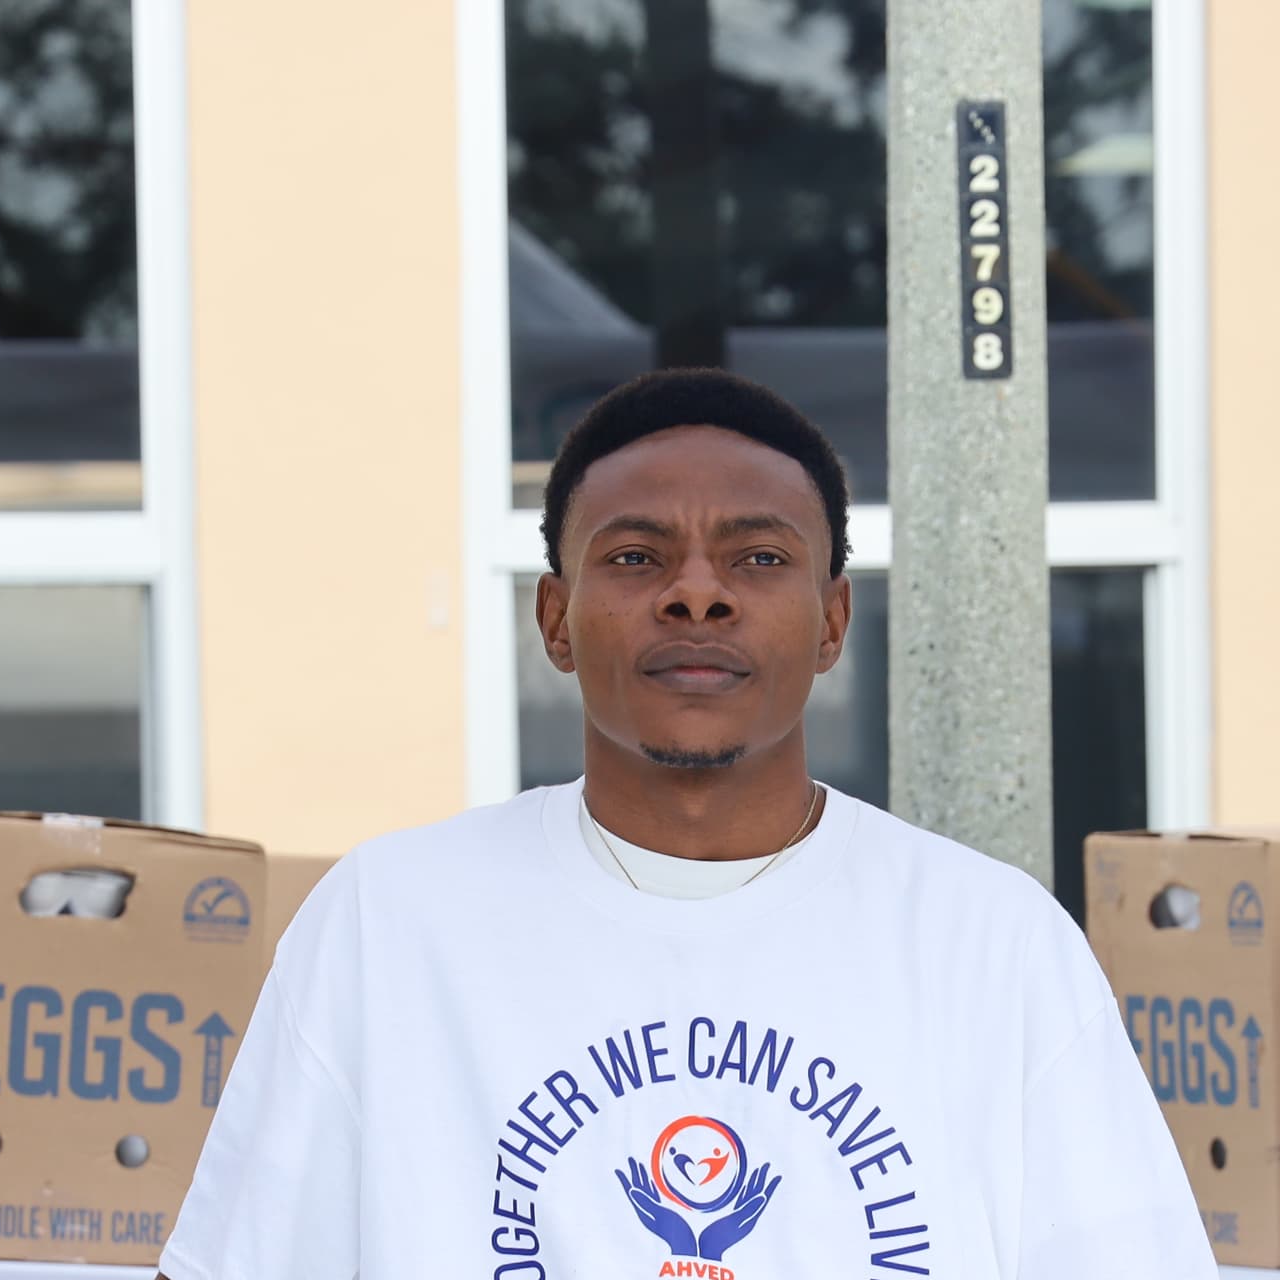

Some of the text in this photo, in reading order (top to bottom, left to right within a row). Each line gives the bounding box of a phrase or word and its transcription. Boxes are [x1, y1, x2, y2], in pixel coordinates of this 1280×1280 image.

[969, 154, 1004, 371] 22798
[587, 1021, 676, 1098] WE
[687, 1016, 794, 1093] CAN
[790, 1056, 913, 1191] SAVE
[48, 1207, 103, 1242] WITH
[111, 1209, 167, 1246] CARE
